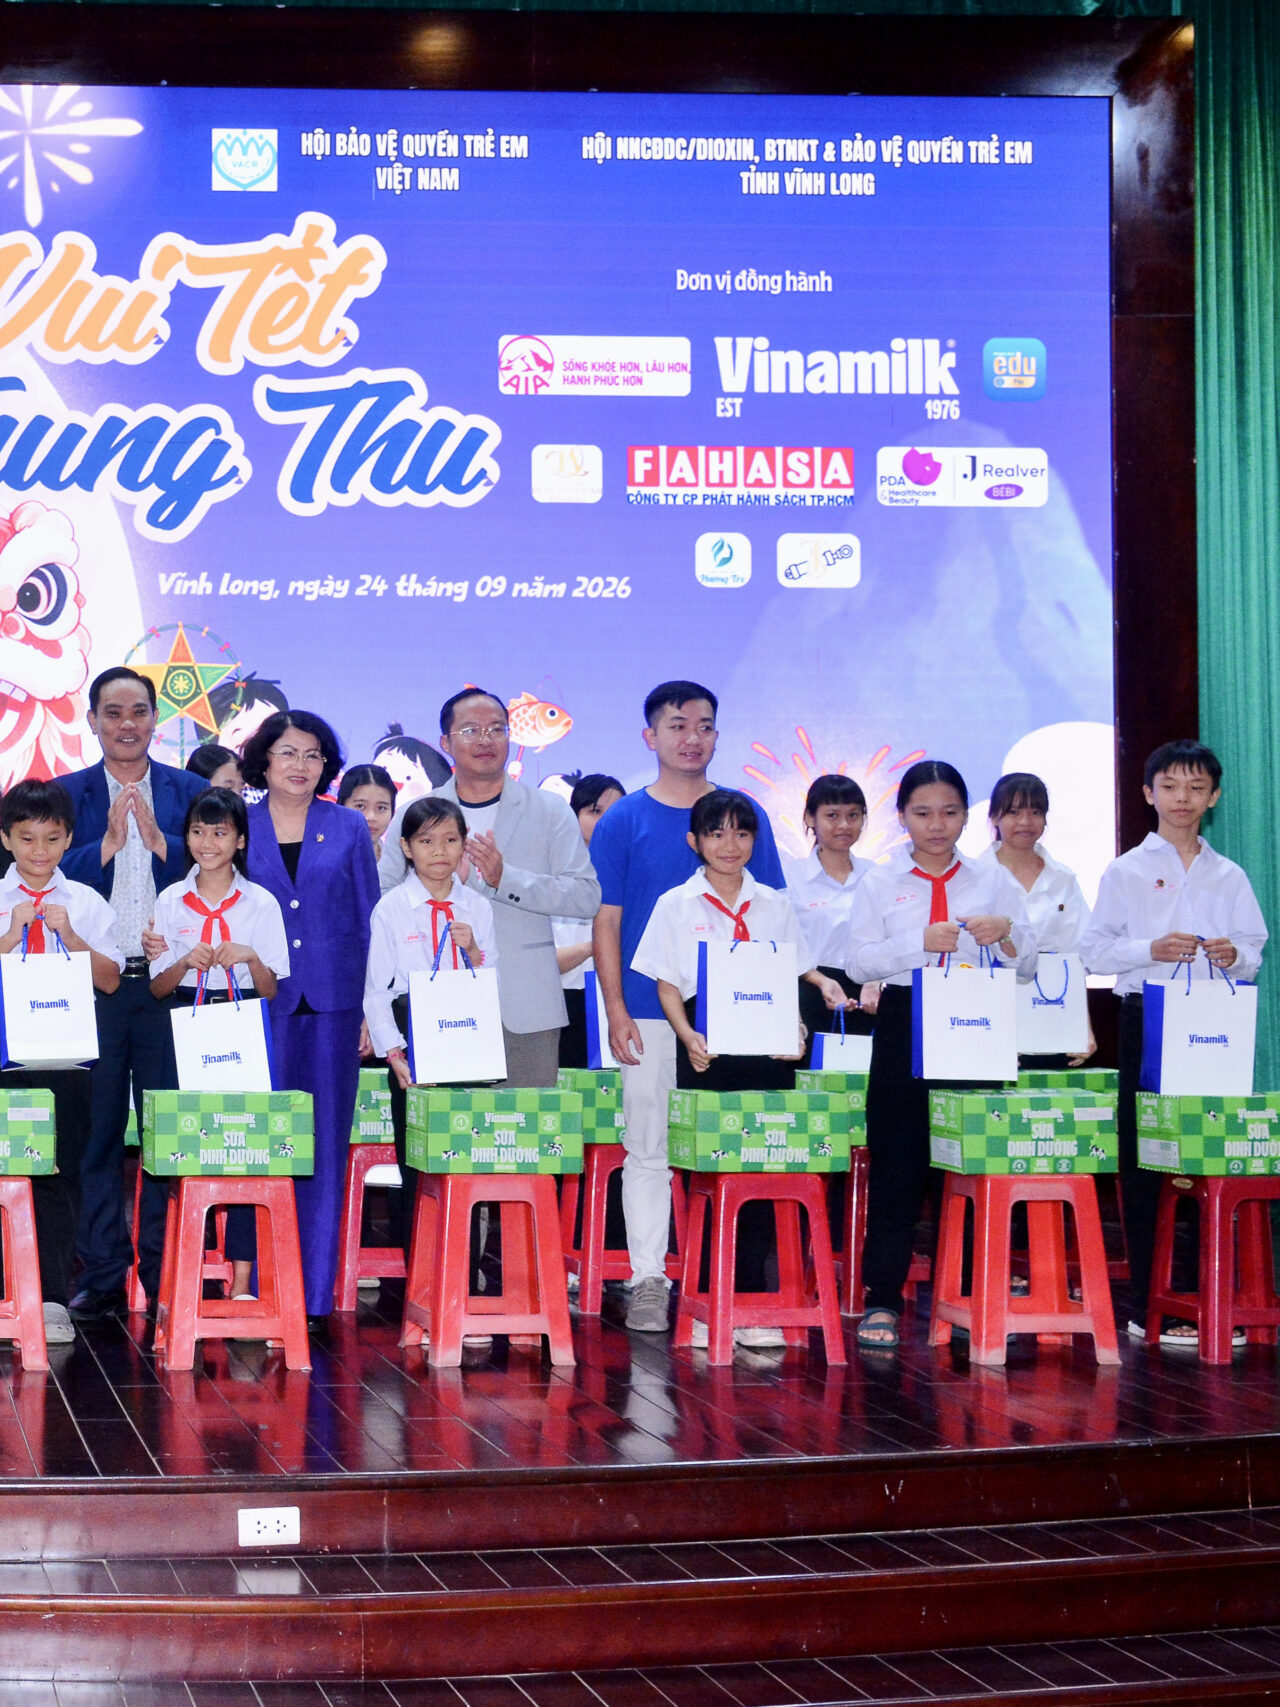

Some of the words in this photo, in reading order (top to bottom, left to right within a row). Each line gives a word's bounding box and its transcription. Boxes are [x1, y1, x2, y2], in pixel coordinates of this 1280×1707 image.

[301, 127, 330, 161] HỘI
[335, 126, 371, 157] BẢO
[376, 128, 398, 161] VỆ
[463, 127, 496, 158] TRẺ
[500, 135, 529, 158] EM
[582, 131, 612, 165] HỘI
[765, 139, 819, 162] BTNKT
[823, 141, 836, 162] &
[841, 132, 876, 162] BẢO
[881, 135, 903, 168] VỆ
[968, 133, 1000, 164] TRẺ
[1004, 141, 1033, 164] EM
[232, 160, 258, 169] VACR
[376, 162, 412, 195] VIỆT
[417, 167, 460, 191] NAM
[739, 164, 779, 195] TỈNH
[784, 167, 825, 195] VĨNH
[830, 172, 876, 196] LONG
[676, 268, 712, 291] Đơn
[715, 270, 732, 294] vị
[734, 267, 782, 295] đồng
[785, 270, 833, 292] hành
[184, 222, 375, 364] Tết
[713, 337, 960, 395] Vinamilk
[993, 351, 1037, 375] edu
[503, 374, 550, 395] AIA
[716, 397, 743, 418] EST
[925, 399, 960, 420] 1976
[265, 380, 494, 504] Thu
[634, 450, 852, 485] FAHASA
[983, 464, 1046, 478] Realver
[880, 476, 906, 486] PDA
[627, 490, 660, 505] CÔNG
[663, 493, 678, 504] TY
[682, 493, 698, 505] CP
[703, 491, 732, 505] PHÁT
[737, 491, 770, 505] HÀNH
[775, 491, 806, 506] SÁCH
[810, 494, 855, 506] TP.HCM
[888, 489, 936, 497] Healthcare
[888, 497, 919, 506] Beauty
[157, 572, 212, 596] Vĩnh
[219, 573, 279, 599] Long,
[287, 575, 349, 602] ngày
[355, 575, 388, 597] 24
[395, 574, 468, 602] tháng
[475, 575, 507, 597] 09
[512, 576, 567, 598] năm
[572, 576, 632, 598] 2026
[733, 991, 773, 1001] Vinamilk
[30, 999, 69, 1009] Vinamilk
[438, 1018, 477, 1028] Vinamilk
[949, 1017, 991, 1027] Vinamilk
[1189, 1034, 1228, 1043] Vinamilk
[201, 1051, 241, 1064] Vinamilk
[471, 1148, 498, 1163] DINH
[741, 1148, 769, 1163] DINH
[1007, 1141, 1036, 1156] DINH
[200, 1149, 228, 1164] DINH
